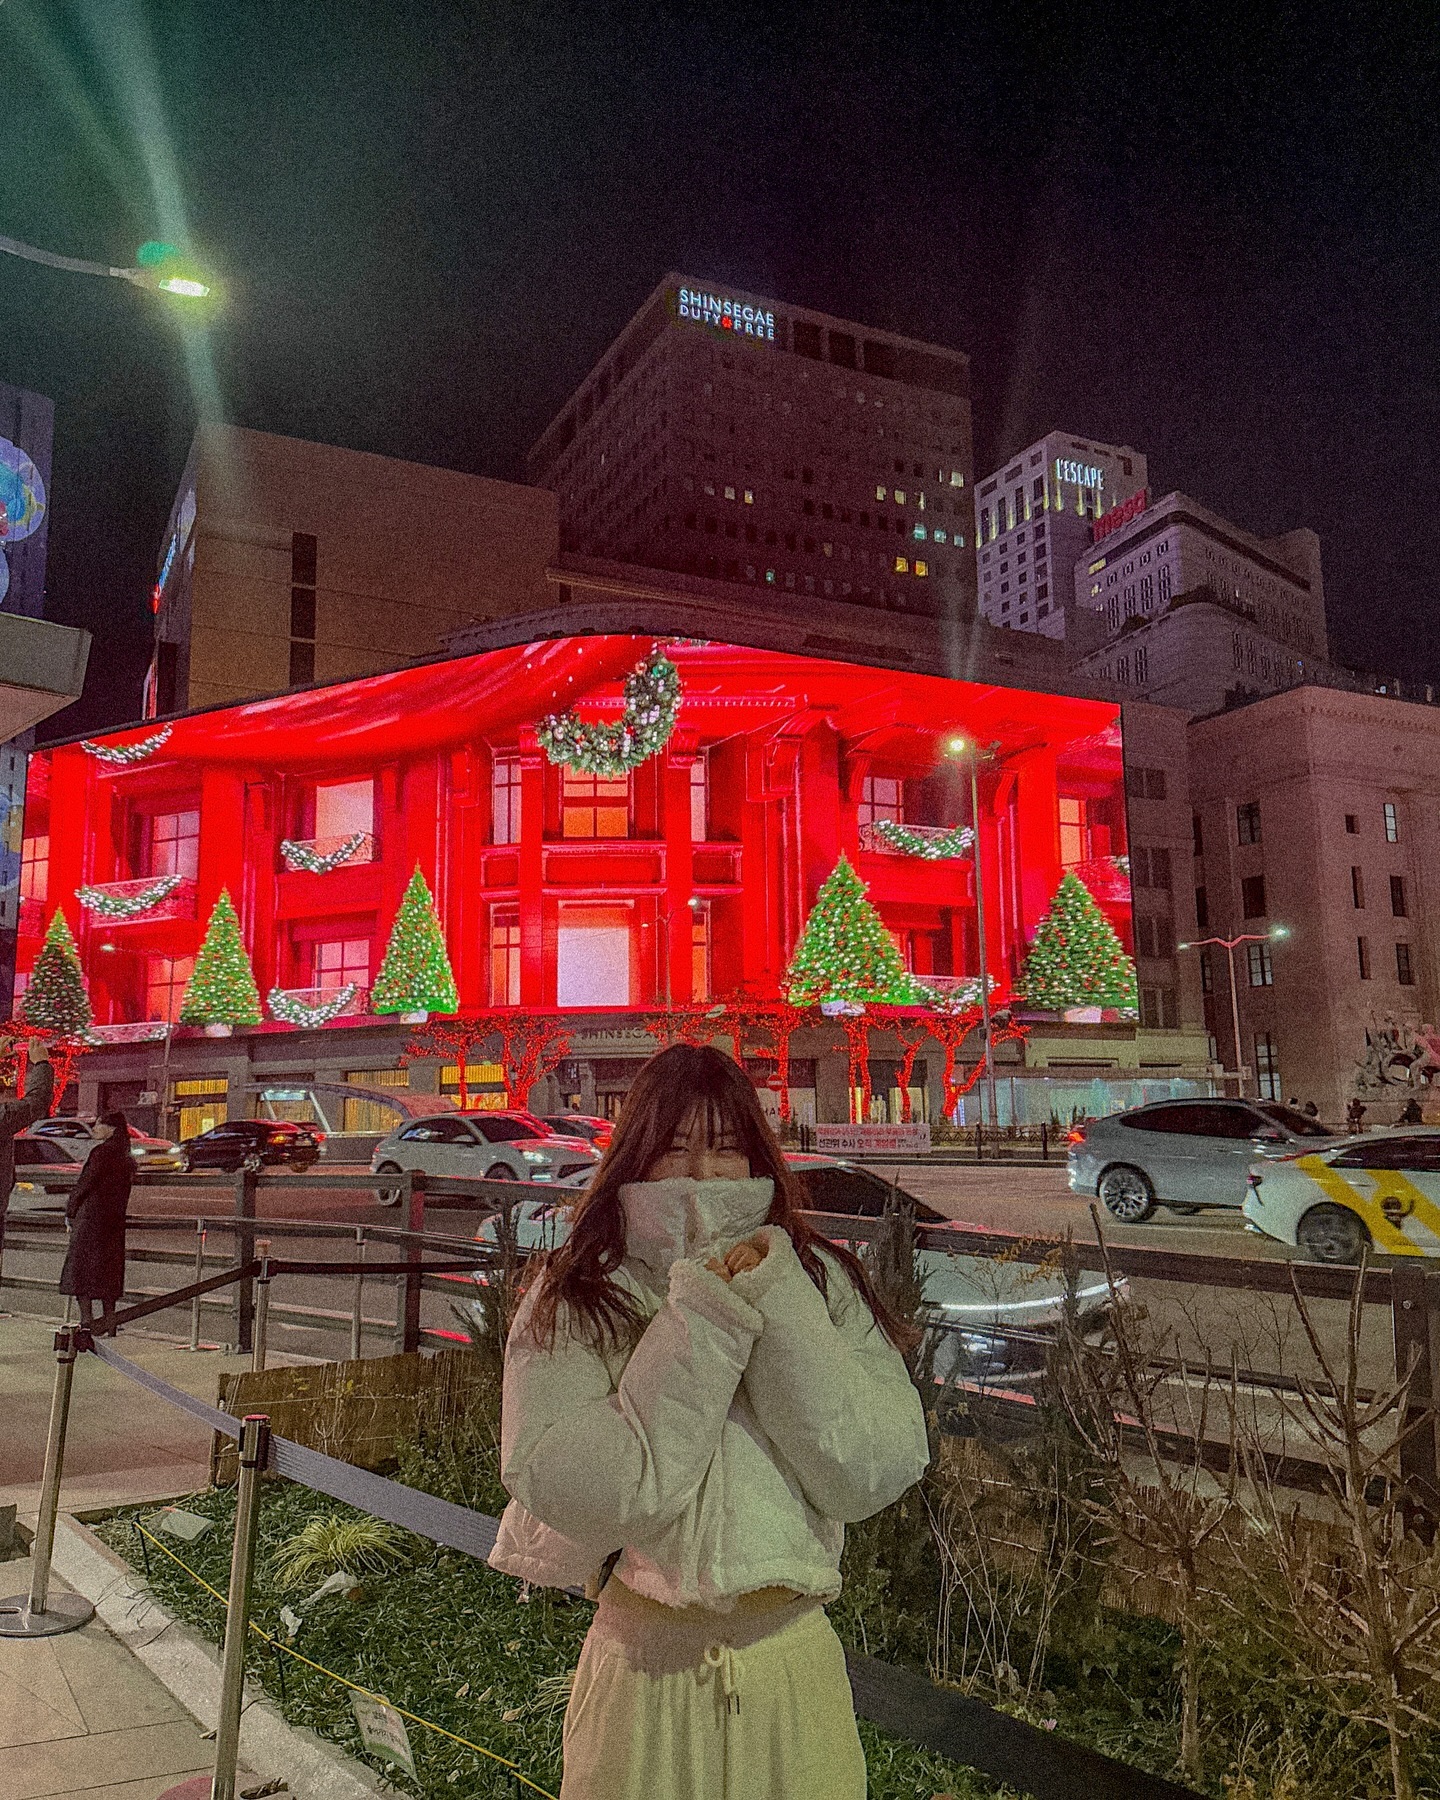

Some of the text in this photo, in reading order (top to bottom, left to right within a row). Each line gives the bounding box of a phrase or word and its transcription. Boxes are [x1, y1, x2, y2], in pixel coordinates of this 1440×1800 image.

[679, 288, 775, 328] SHINSEGAE
[679, 303, 775, 341] DUTY FREE
[1056, 458, 1105, 491] L'ESCAPE
